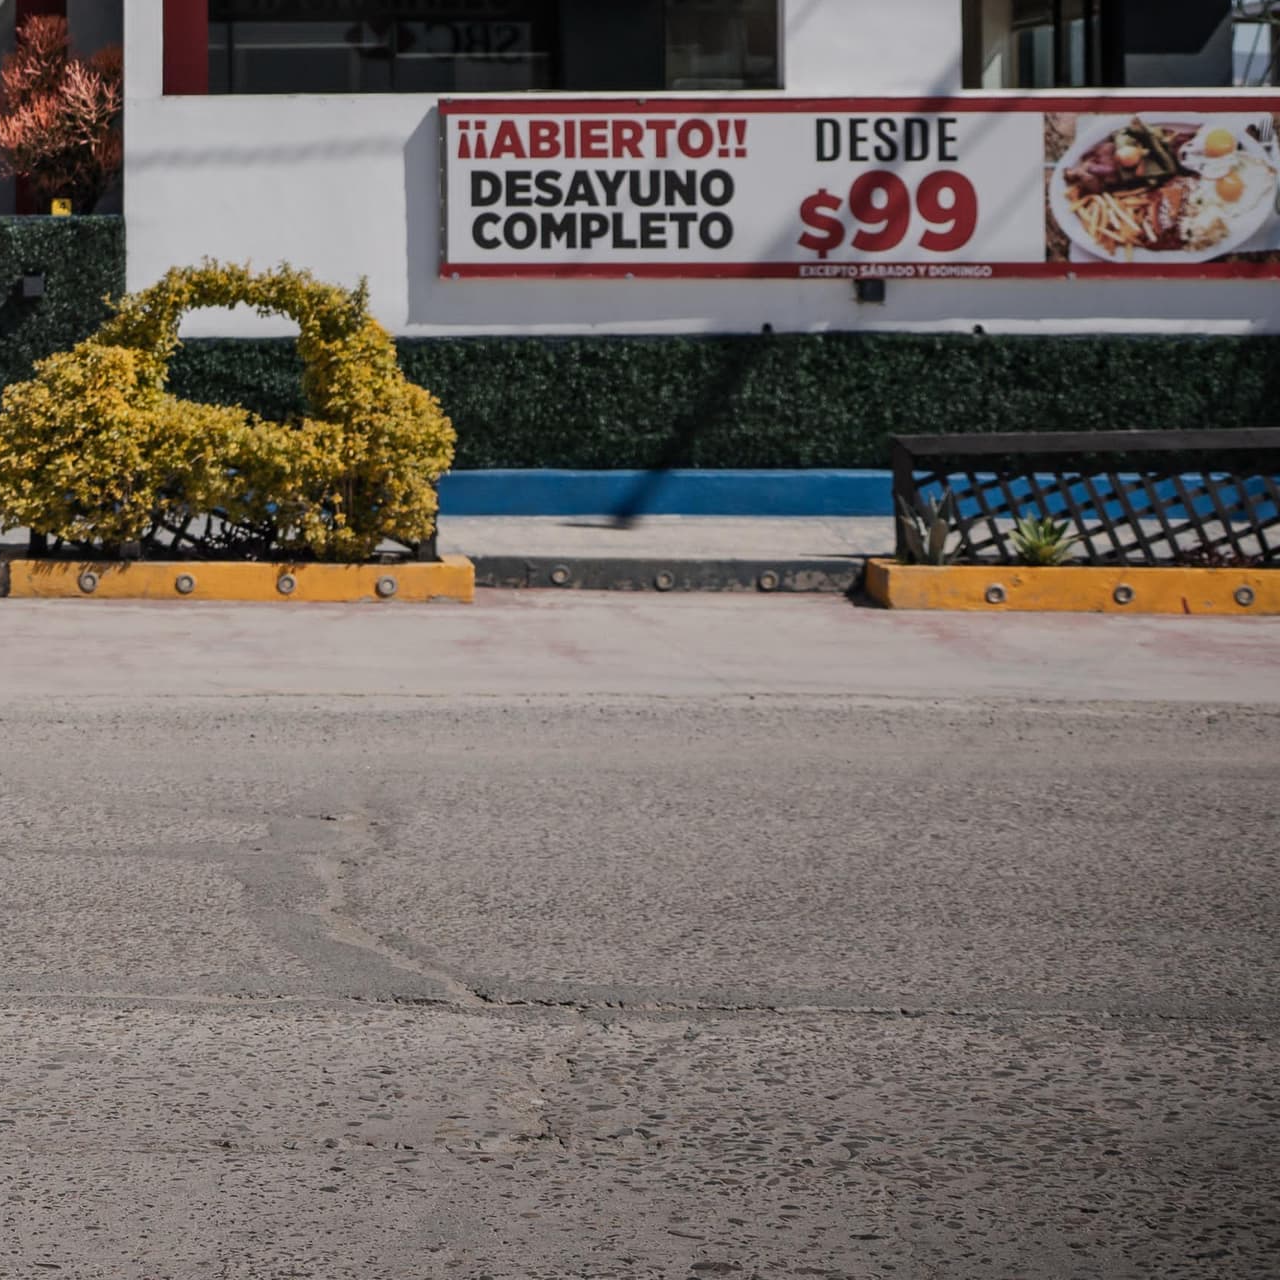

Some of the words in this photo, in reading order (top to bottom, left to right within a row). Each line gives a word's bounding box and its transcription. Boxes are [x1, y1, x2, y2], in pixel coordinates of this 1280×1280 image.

[458, 120, 747, 159] ¡¡ABIERTO!!
[816, 117, 958, 163] DESDE
[471, 169, 734, 207] DESAYUNO
[472, 212, 733, 250] COMPLETO
[799, 170, 978, 259] $99
[800, 264, 858, 277] EXCEPTO
[860, 262, 916, 277] SÁBADO
[917, 264, 928, 277] Y
[928, 264, 992, 277] DOMINGO
